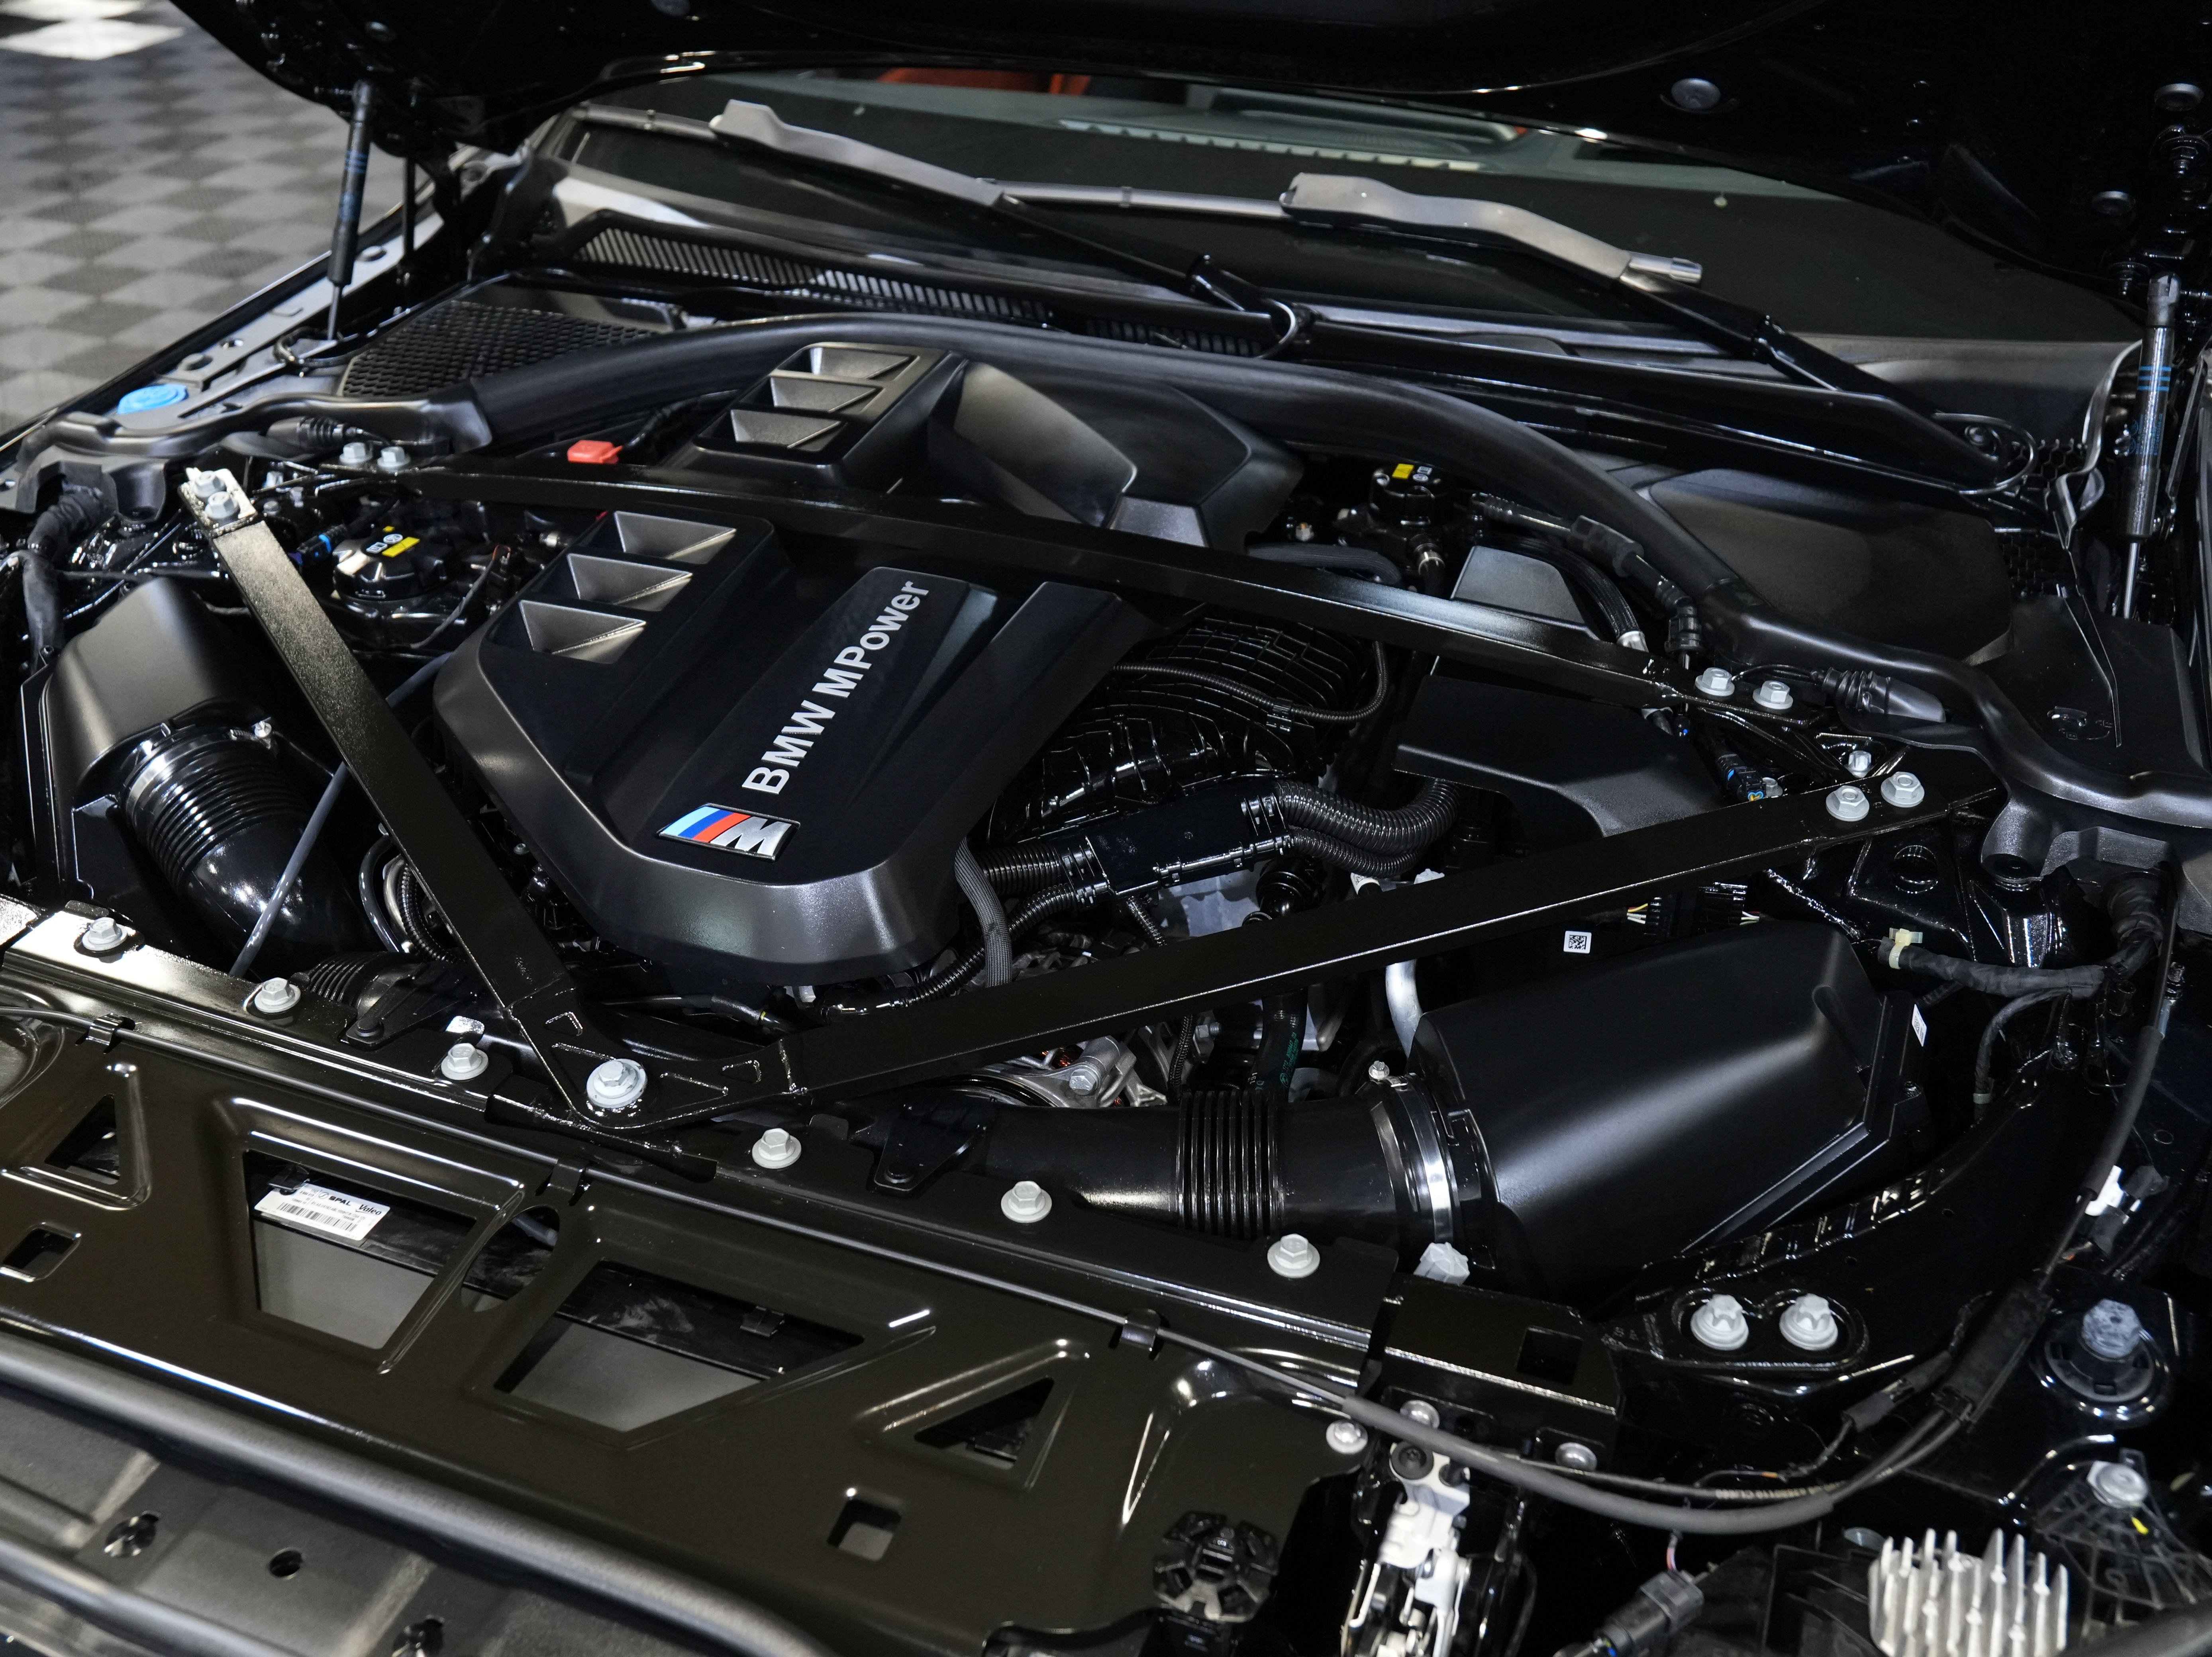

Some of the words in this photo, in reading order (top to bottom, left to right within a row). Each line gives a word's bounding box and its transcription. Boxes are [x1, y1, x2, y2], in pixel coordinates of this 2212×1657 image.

[741, 700, 835, 794] BMW
[812, 581, 929, 698] MPower
[710, 817, 792, 856] M
[329, 1196, 351, 1206] SPAL
[359, 1204, 382, 1215] Valeo
